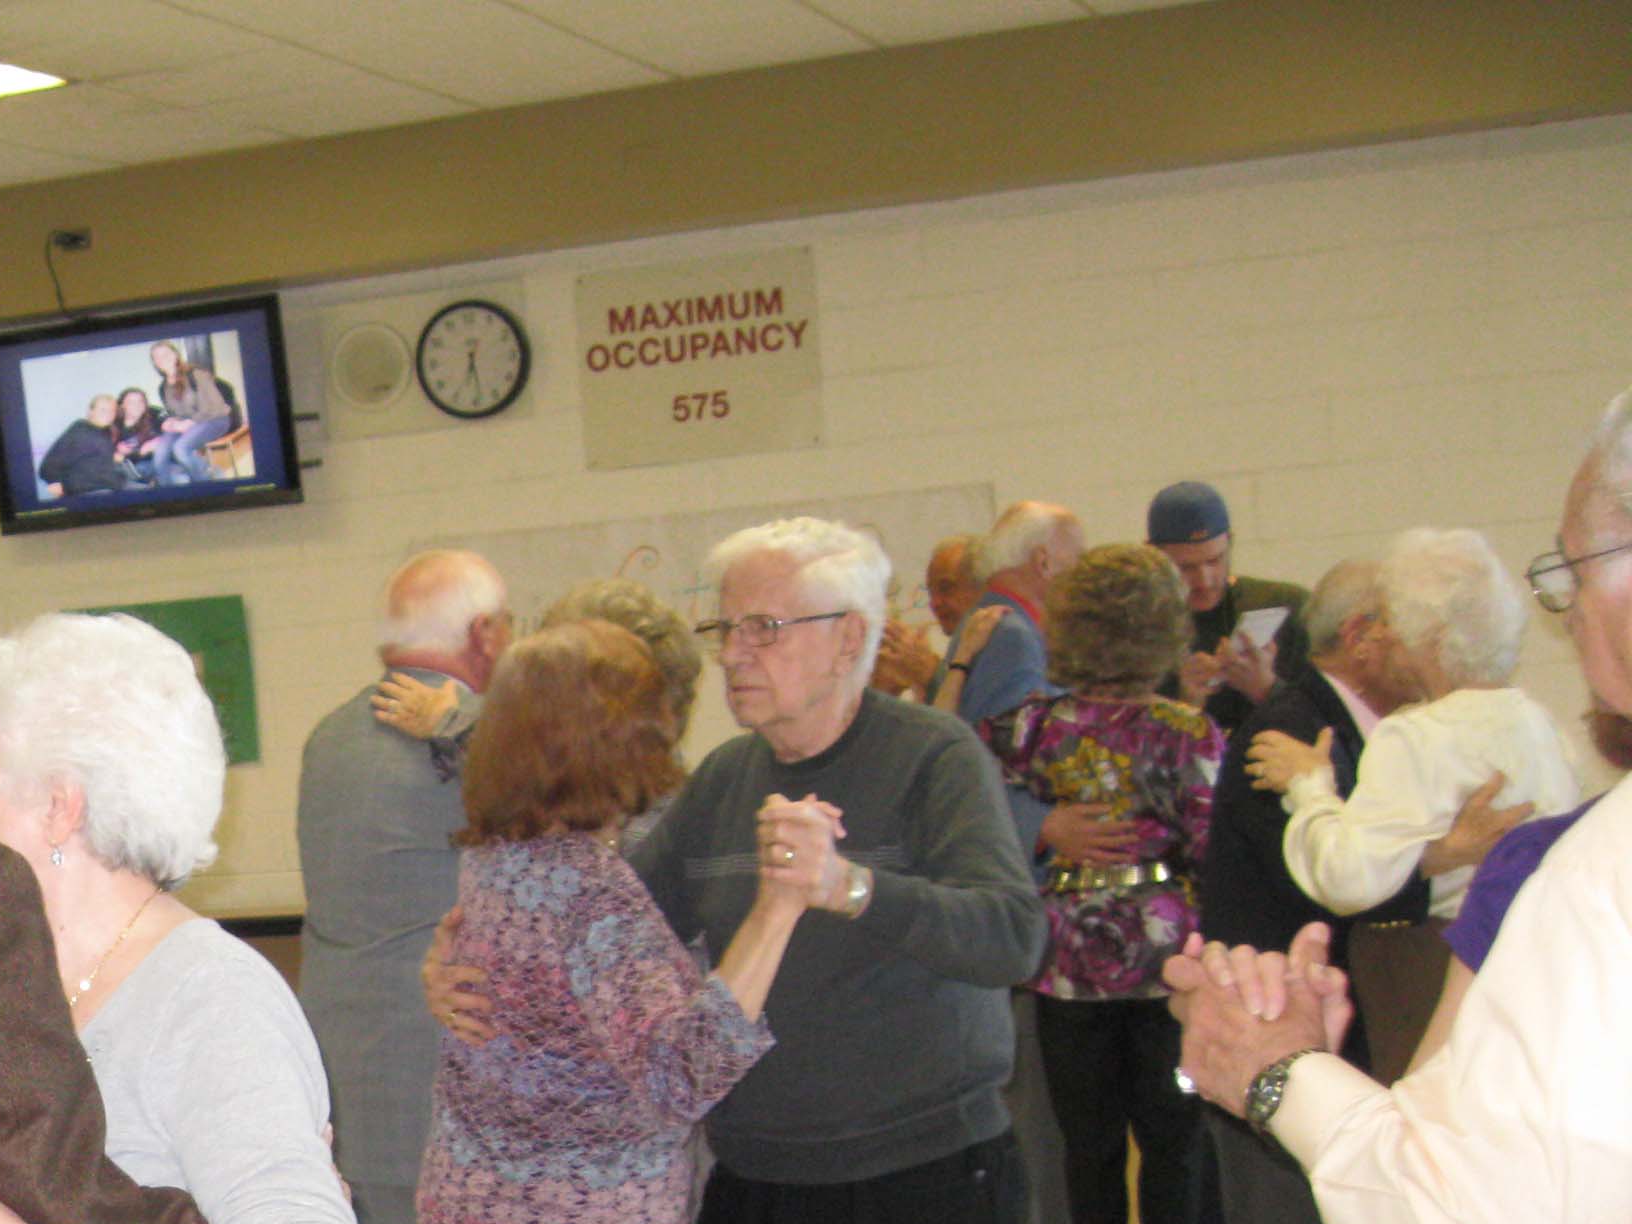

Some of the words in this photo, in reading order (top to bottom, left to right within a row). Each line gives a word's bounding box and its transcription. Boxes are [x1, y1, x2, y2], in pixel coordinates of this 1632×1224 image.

[607, 287, 784, 334] MAXIMUM
[586, 319, 809, 372] OCCUPANCY
[672, 391, 730, 422] 575
